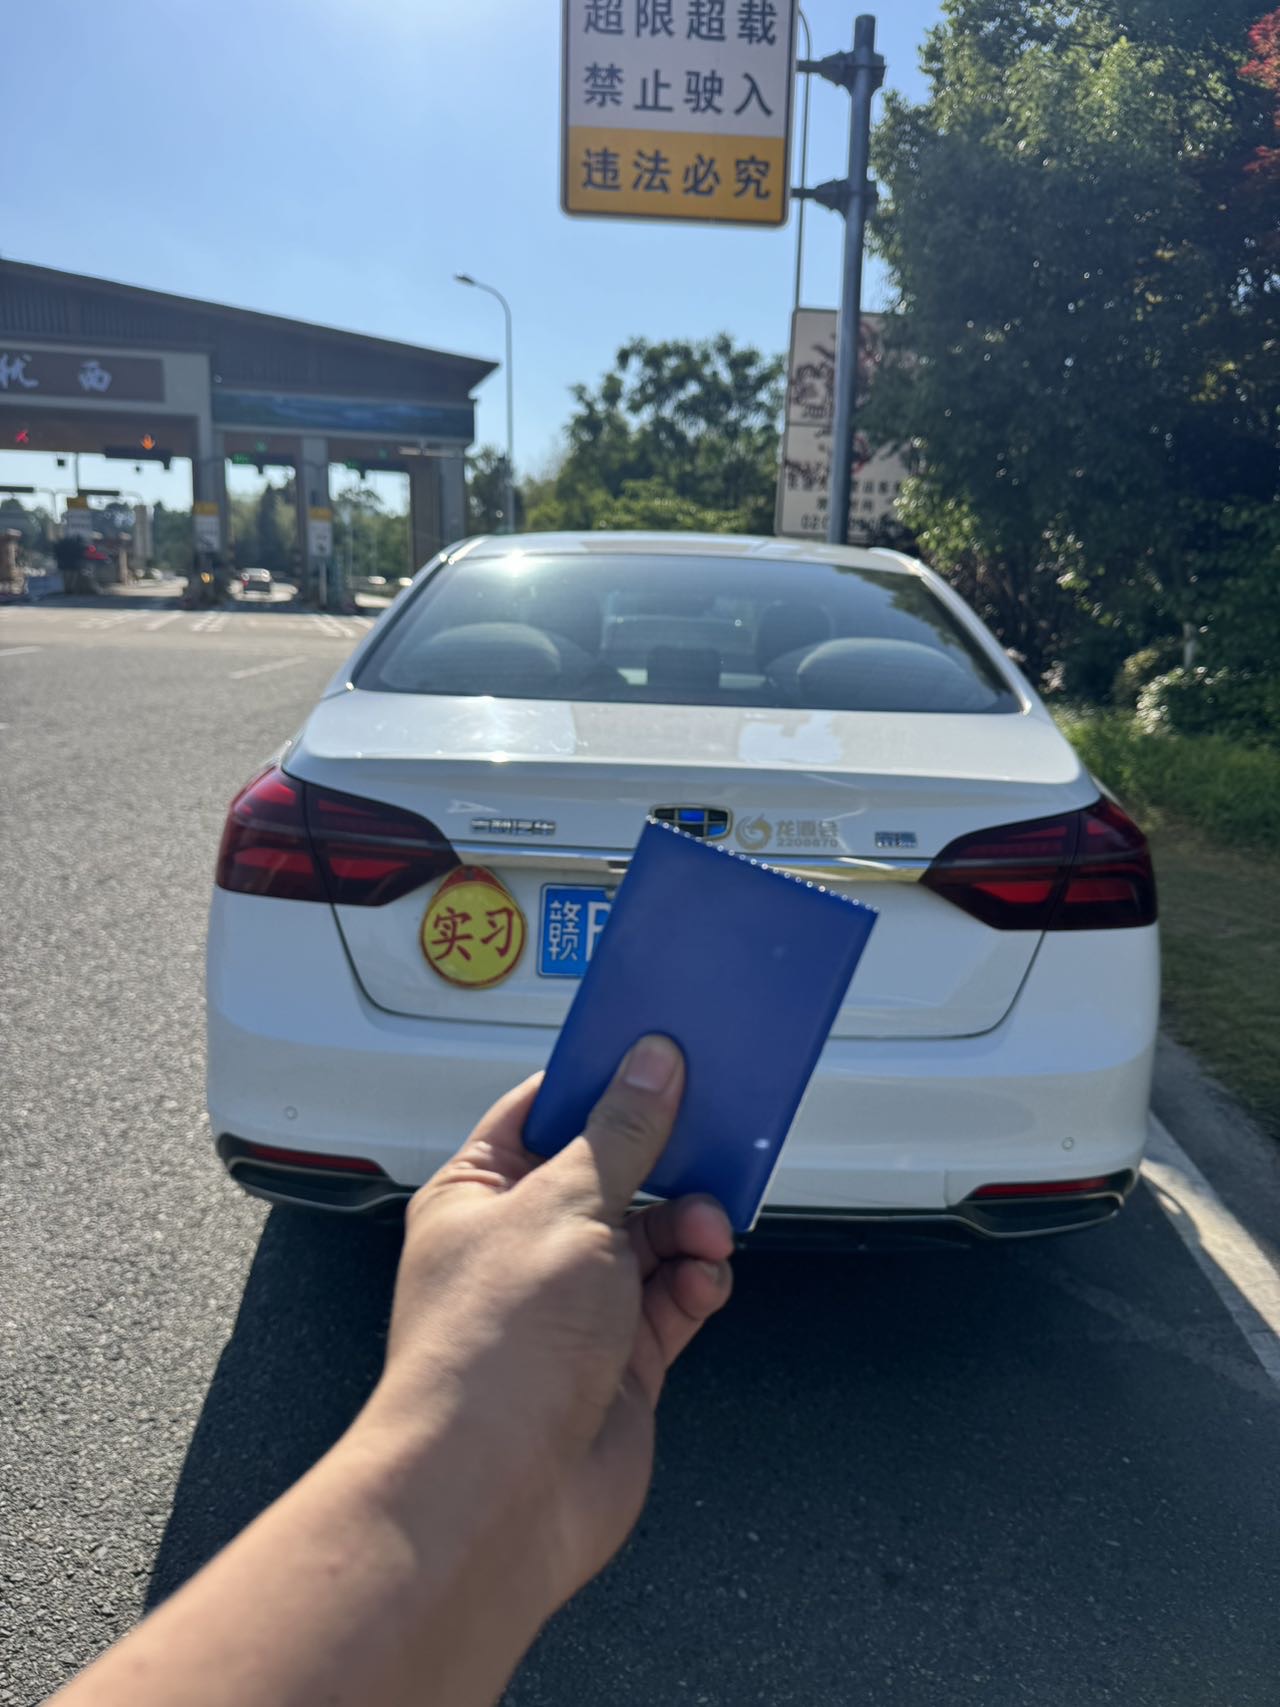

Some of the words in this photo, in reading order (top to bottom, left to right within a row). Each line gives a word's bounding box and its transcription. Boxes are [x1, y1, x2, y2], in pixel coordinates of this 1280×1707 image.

[583, 0, 777, 46] 超限超载
[583, 62, 773, 117] 禁止驶入
[581, 147, 771, 200] 违法必究
[431, 906, 515, 961] 实习
